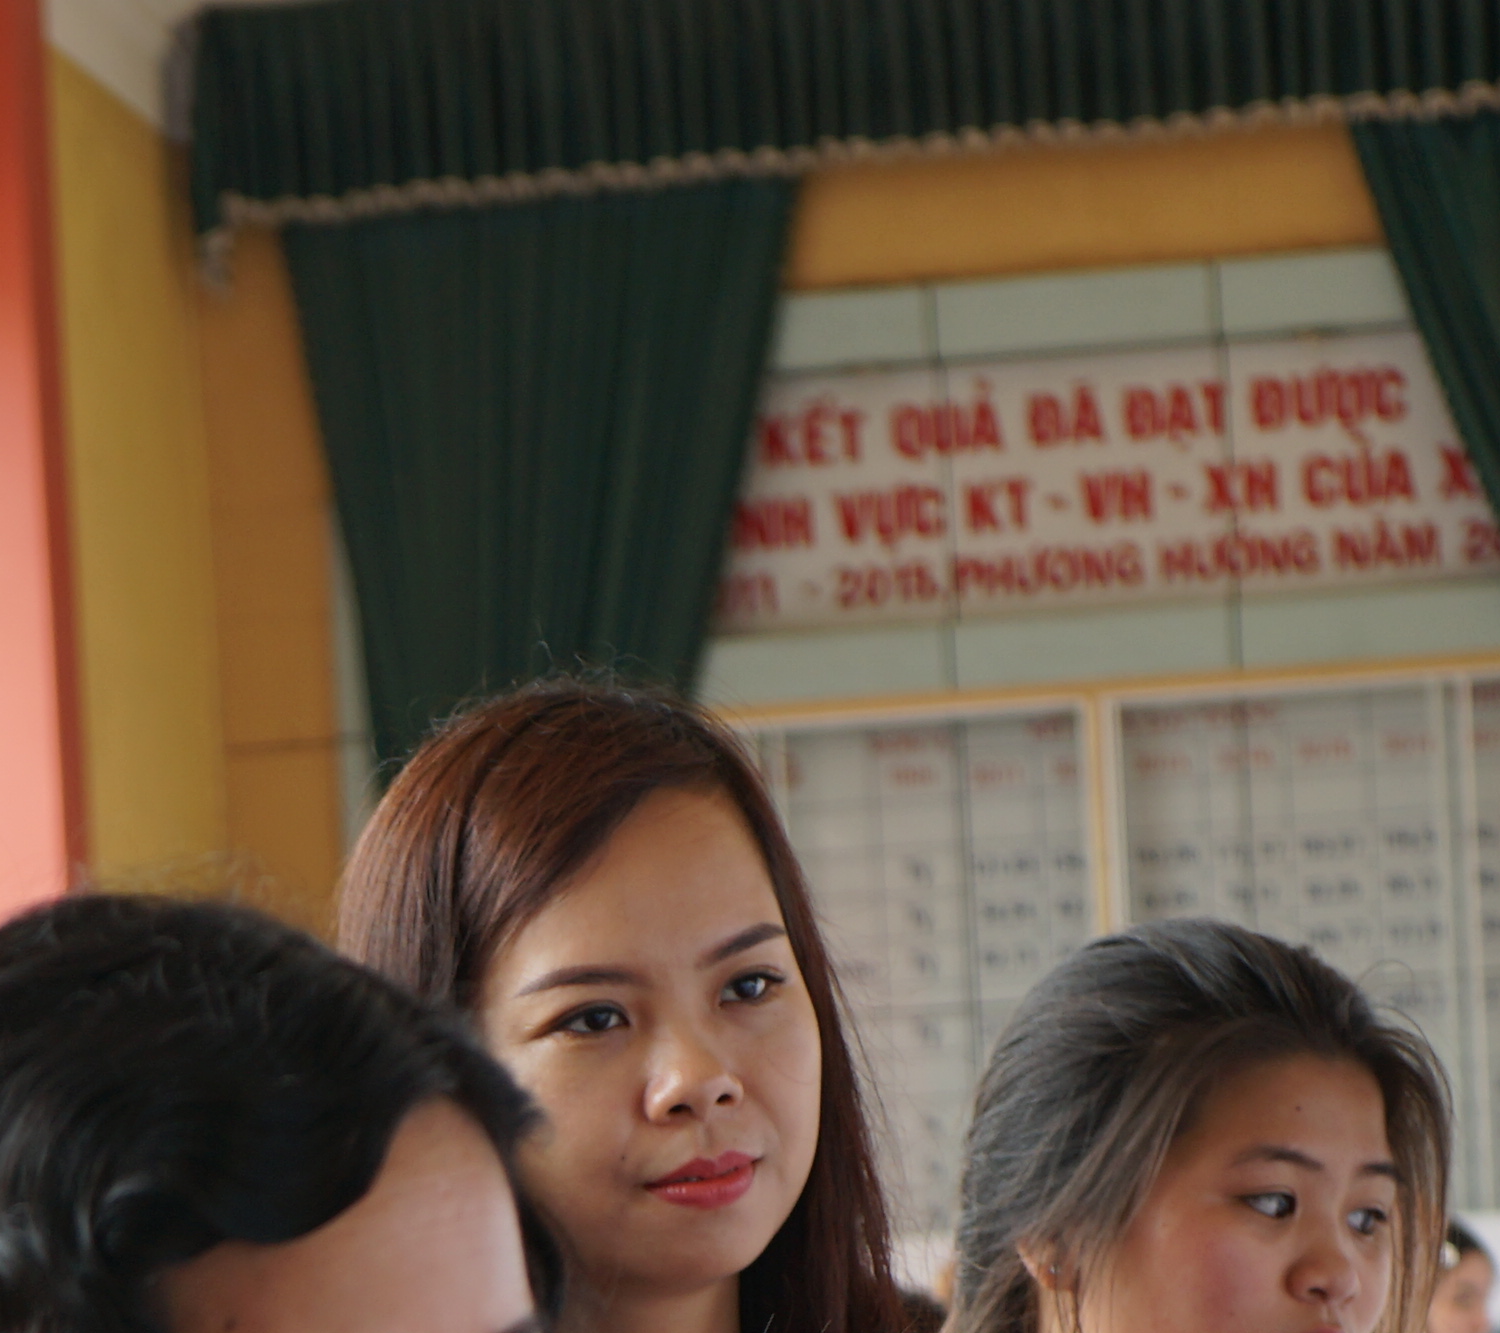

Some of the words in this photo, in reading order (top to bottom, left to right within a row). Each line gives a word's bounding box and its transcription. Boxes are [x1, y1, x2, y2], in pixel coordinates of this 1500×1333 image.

[757, 393, 862, 466] KẾT
[888, 377, 1005, 463] QUẢ
[1026, 379, 1104, 449] ĐÃ
[1122, 378, 1225, 450] ĐẠT
[1252, 363, 1406, 440] ĐƯỢC
[836, 484, 943, 553] VỰC
[966, 477, 1031, 533] KT
[1204, 457, 1278, 514] XH
[1303, 441, 1413, 508] CỦA
[1439, 445, 1480, 497] X
[953, 546, 1144, 595] PHƯƠNG
[1158, 528, 1319, 584] HƯỚNG
[1332, 516, 1439, 571] NĂM
